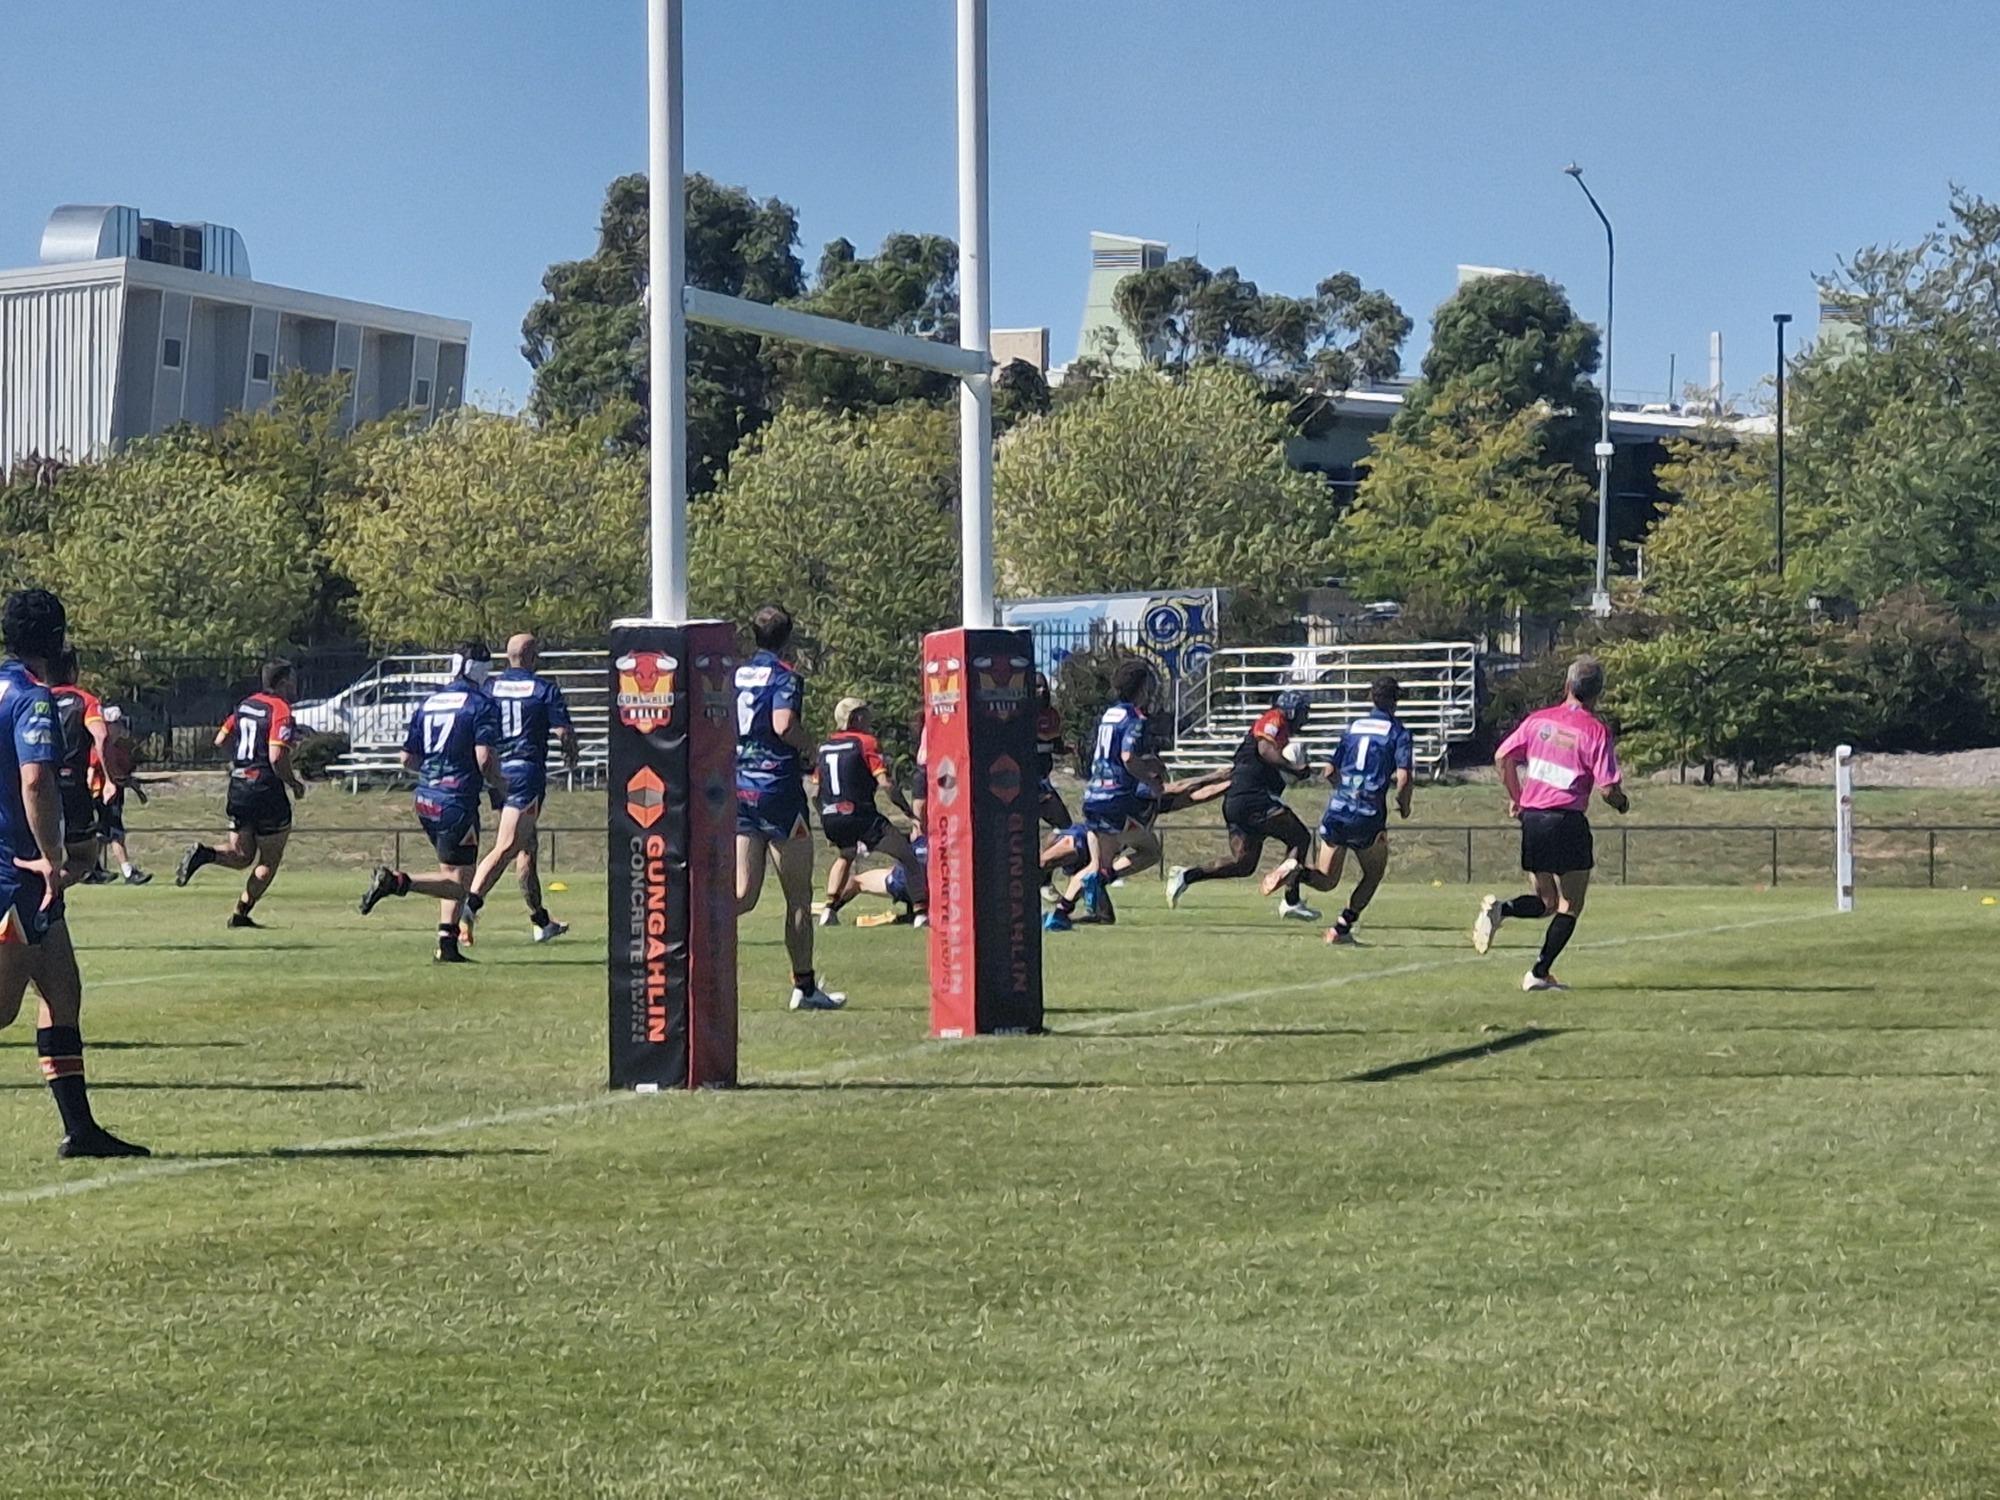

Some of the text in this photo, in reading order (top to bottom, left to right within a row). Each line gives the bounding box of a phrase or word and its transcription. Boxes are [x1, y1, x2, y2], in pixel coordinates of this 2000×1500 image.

[423, 713, 456, 754] 17
[501, 700, 522, 738] 11
[825, 753, 841, 795] 1
[630, 836, 645, 964] CONCRETE
[646, 834, 667, 1042] GUNGAHLIN
